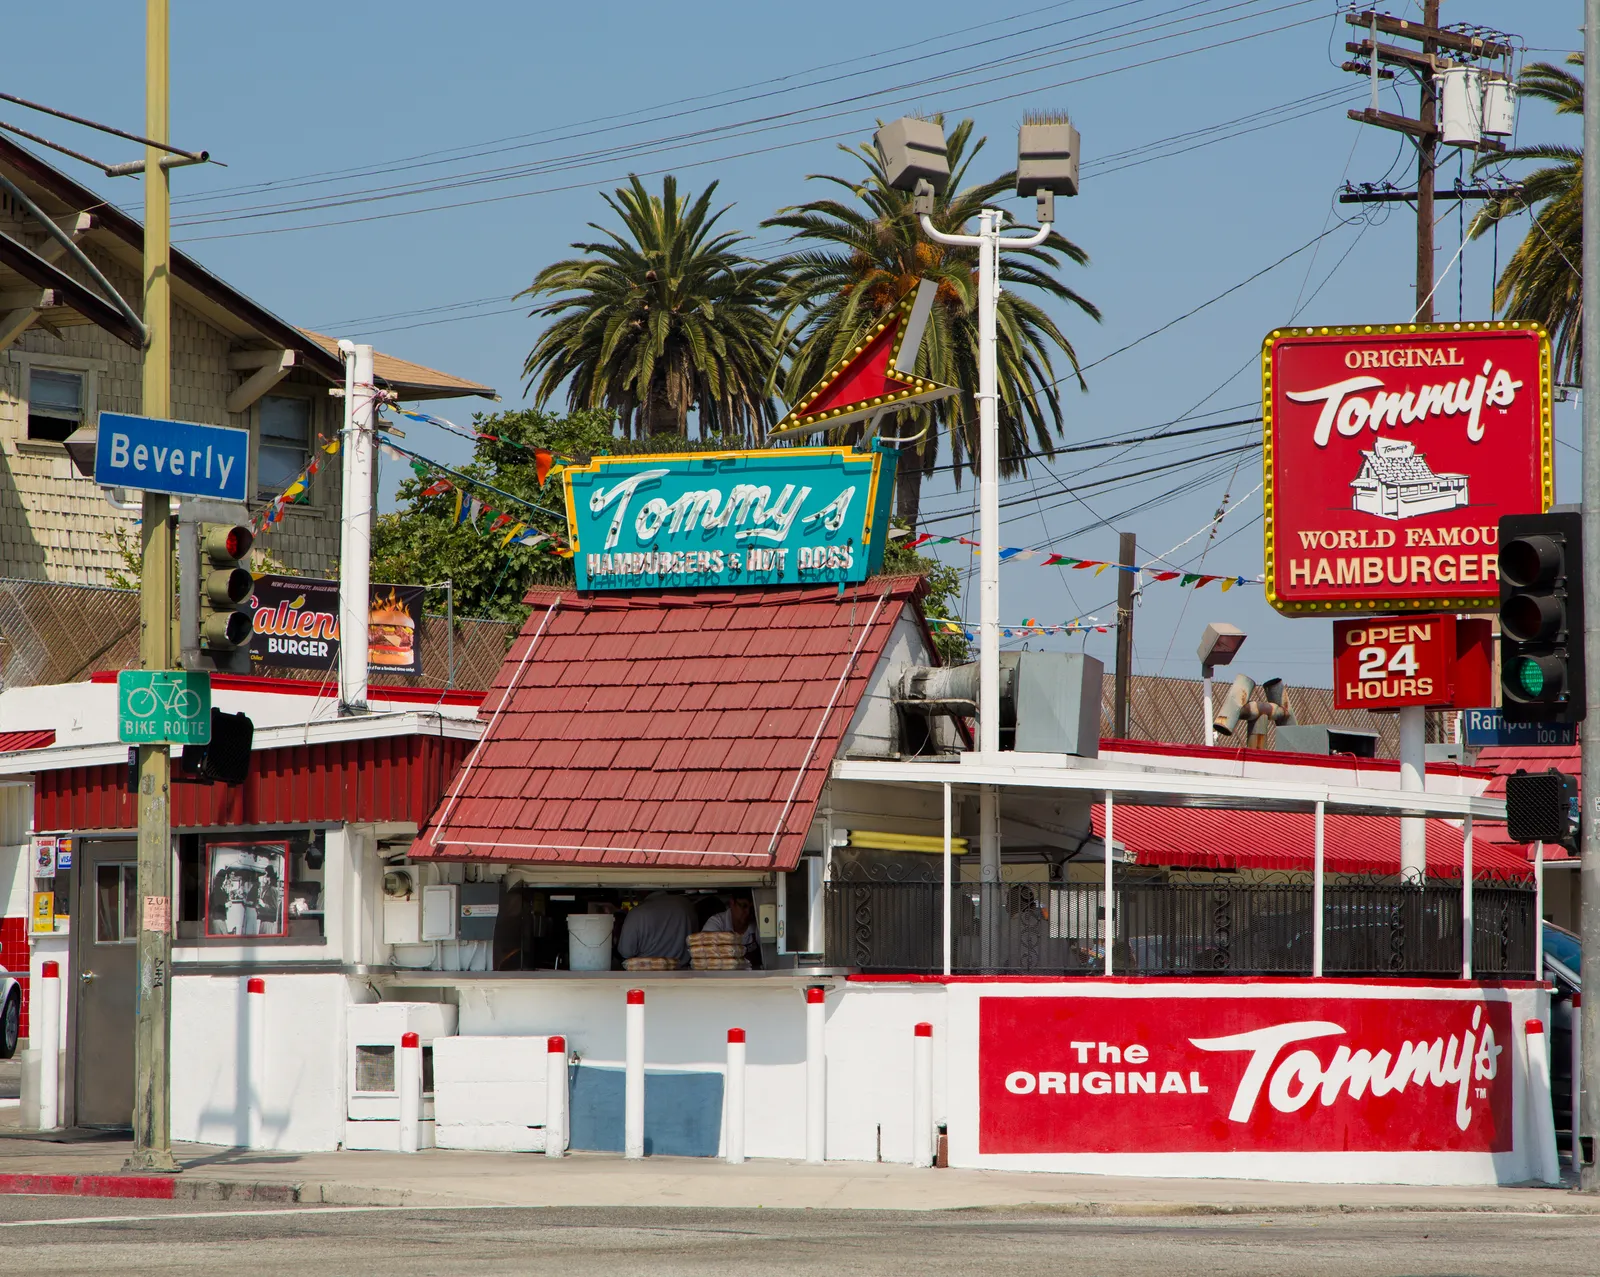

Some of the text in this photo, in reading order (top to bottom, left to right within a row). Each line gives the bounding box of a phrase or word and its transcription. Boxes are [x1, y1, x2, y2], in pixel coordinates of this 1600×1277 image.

[1344, 348, 1465, 369] ORIGINAL
[1285, 359, 1523, 447] Tommy's
[110, 432, 235, 490] Beverly
[1297, 526, 1500, 550] WORLD FAMOU
[586, 544, 854, 576] HAMBURGERS & HOT DOGS
[1289, 553, 1500, 586] HAMBURGER
[250, 594, 340, 641] alien
[1346, 623, 1431, 646] OPEN
[268, 637, 329, 657] BURGER
[1358, 643, 1420, 680] 24
[1346, 677, 1433, 700] HOURS
[125, 720, 205, 736] BIKE ROUTE
[1537, 729, 1570, 743] 100 N
[1070, 1041, 1149, 1064] The
[1188, 1005, 1503, 1132] Tommy's TM
[1005, 1071, 1209, 1095] ORIGINAL
